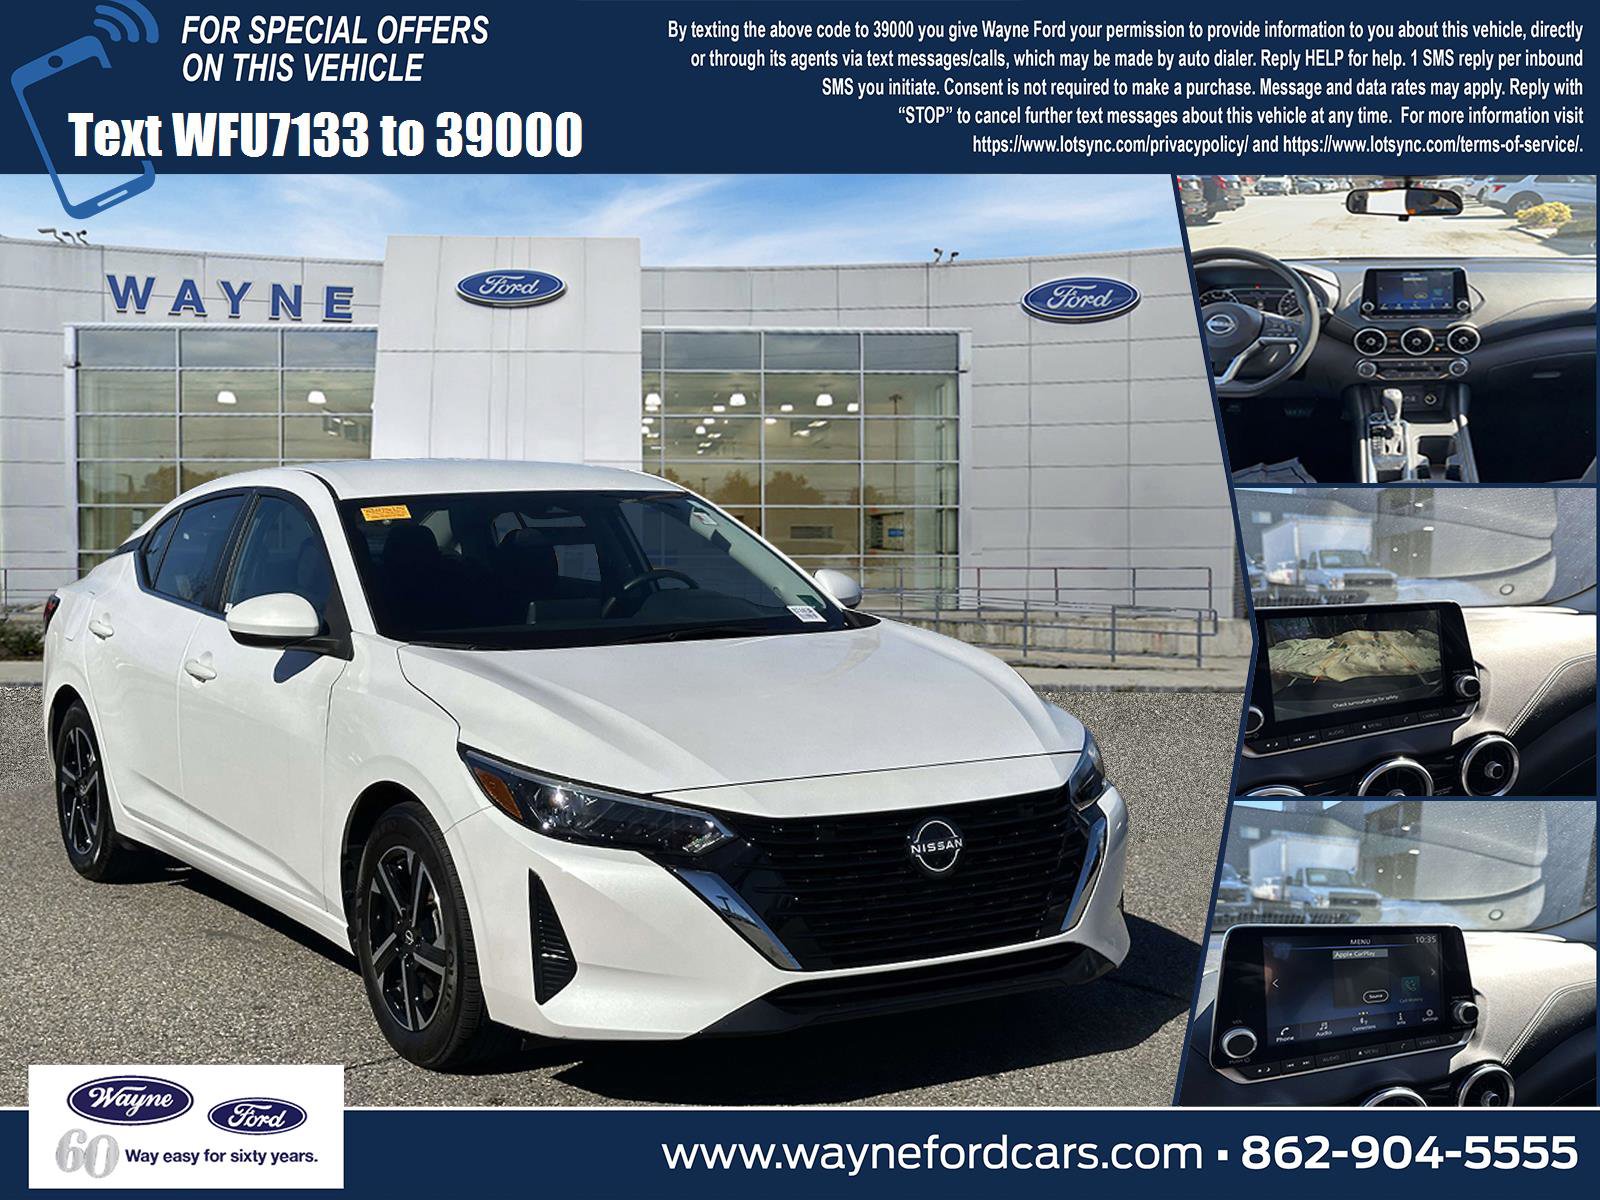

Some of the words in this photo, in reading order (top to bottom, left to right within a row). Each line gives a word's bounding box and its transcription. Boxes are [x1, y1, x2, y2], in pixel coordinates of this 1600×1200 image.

[477, 274, 540, 298] Ford
[107, 273, 355, 321] WAYNE
[1046, 284, 1114, 309] Ford
[910, 838, 963, 854] NISSAN
[1415, 935, 1437, 944] 10:35
[1334, 951, 1353, 959] Apple
[1315, 1030, 1333, 1038] Audio
